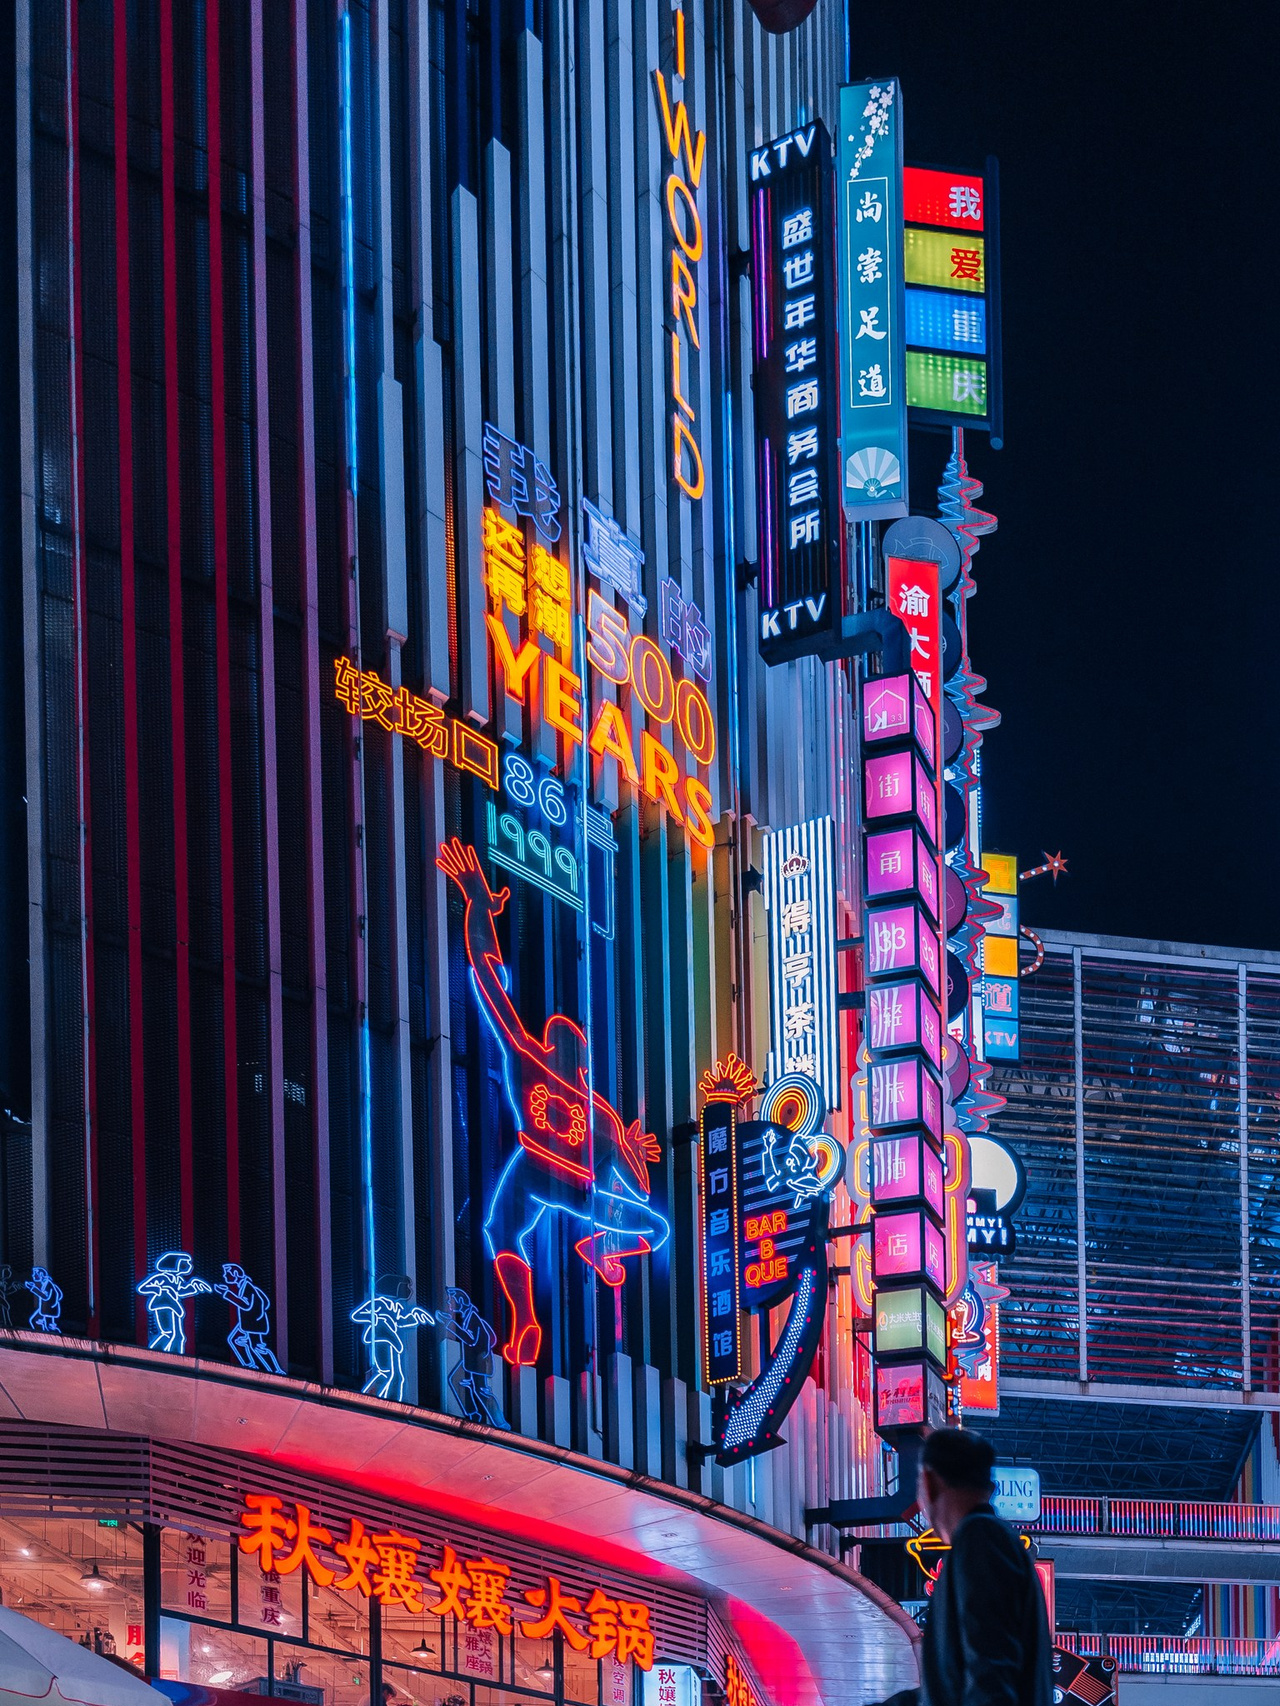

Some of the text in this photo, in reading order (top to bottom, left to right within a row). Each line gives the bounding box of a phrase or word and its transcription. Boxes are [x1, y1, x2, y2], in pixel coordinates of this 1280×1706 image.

[751, 127, 816, 180] KTV
[655, 68, 706, 500] WORLD
[855, 190, 887, 398] 尚崇足道
[949, 186, 983, 404] 我爱重庆
[782, 209, 821, 550] 盛世年华商务会所
[586, 588, 716, 765] 500
[762, 594, 825, 639] KTV
[335, 656, 500, 790] 较场口
[485, 610, 716, 850] YEARS
[487, 801, 579, 895] 1999
[708, 1125, 733, 1358] 魔方音乐酒馆
[745, 1257, 789, 1288] QUE
[746, 1209, 787, 1240] BAR
[759, 1239, 775, 1260] B
